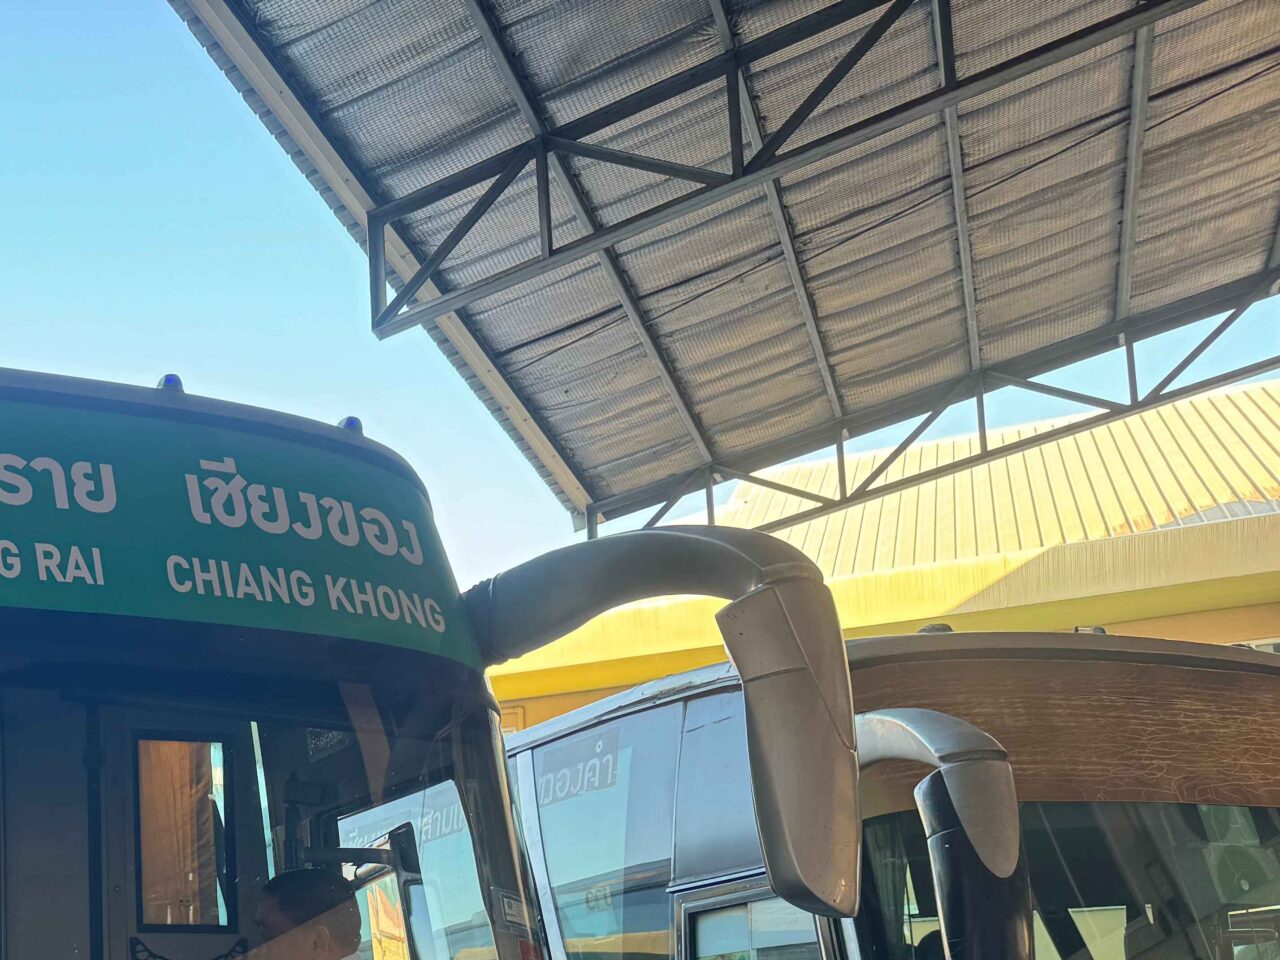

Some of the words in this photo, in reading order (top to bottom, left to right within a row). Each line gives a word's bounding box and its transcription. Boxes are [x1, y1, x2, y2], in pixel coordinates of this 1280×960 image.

[185, 456, 424, 566] เชียงของ
[35, 541, 105, 586] RAI
[166, 554, 316, 607] CHIANG
[325, 573, 447, 633] KHONG
